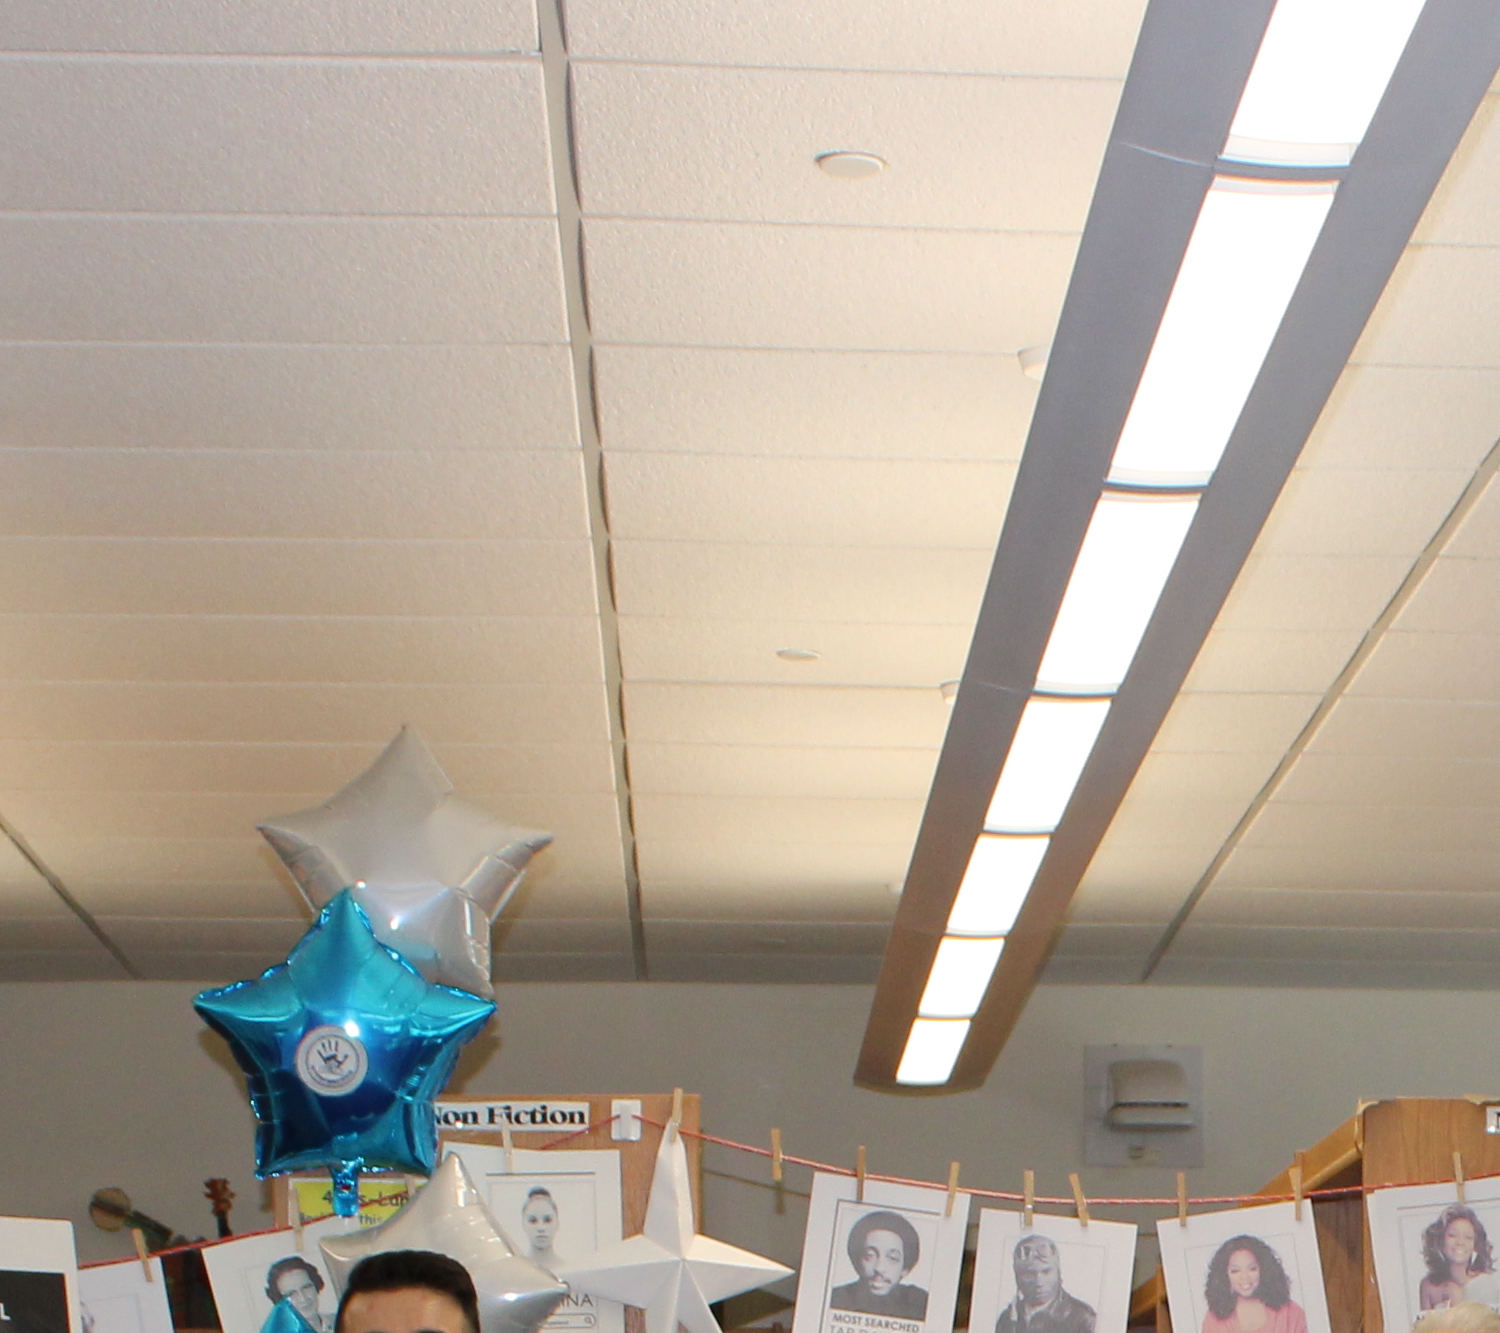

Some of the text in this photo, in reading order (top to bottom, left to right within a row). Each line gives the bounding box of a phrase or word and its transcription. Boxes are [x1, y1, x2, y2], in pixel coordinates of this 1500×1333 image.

[435, 1104, 586, 1125] on Fiction
[833, 1312, 920, 1333] MOST SEARCHED
